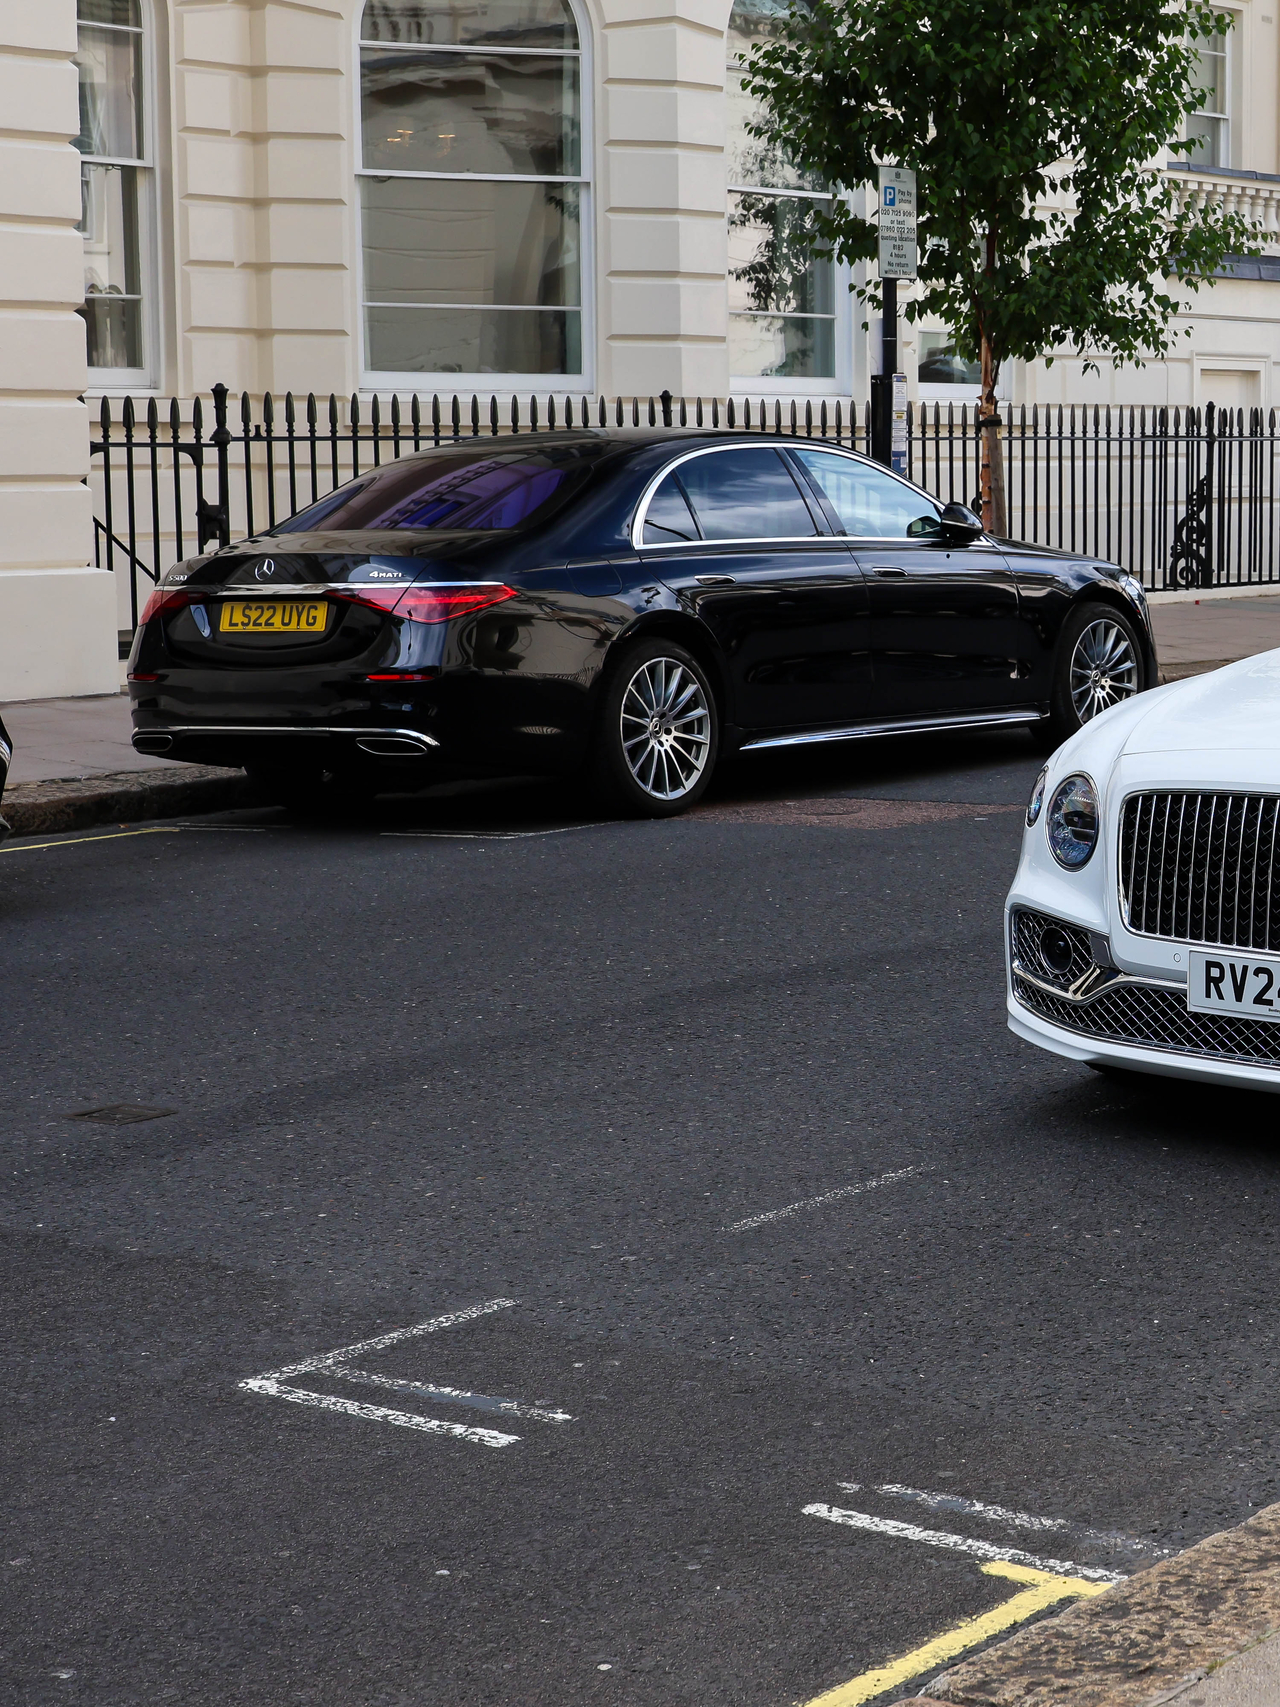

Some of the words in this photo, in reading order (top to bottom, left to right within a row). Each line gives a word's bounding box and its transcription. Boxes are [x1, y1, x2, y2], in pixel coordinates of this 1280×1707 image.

[886, 188, 894, 204] P
[881, 208, 891, 216] 020
[898, 235, 915, 243] location
[369, 570, 406, 578] 4MATI
[228, 604, 277, 627] LS22
[280, 604, 318, 627] UYG
